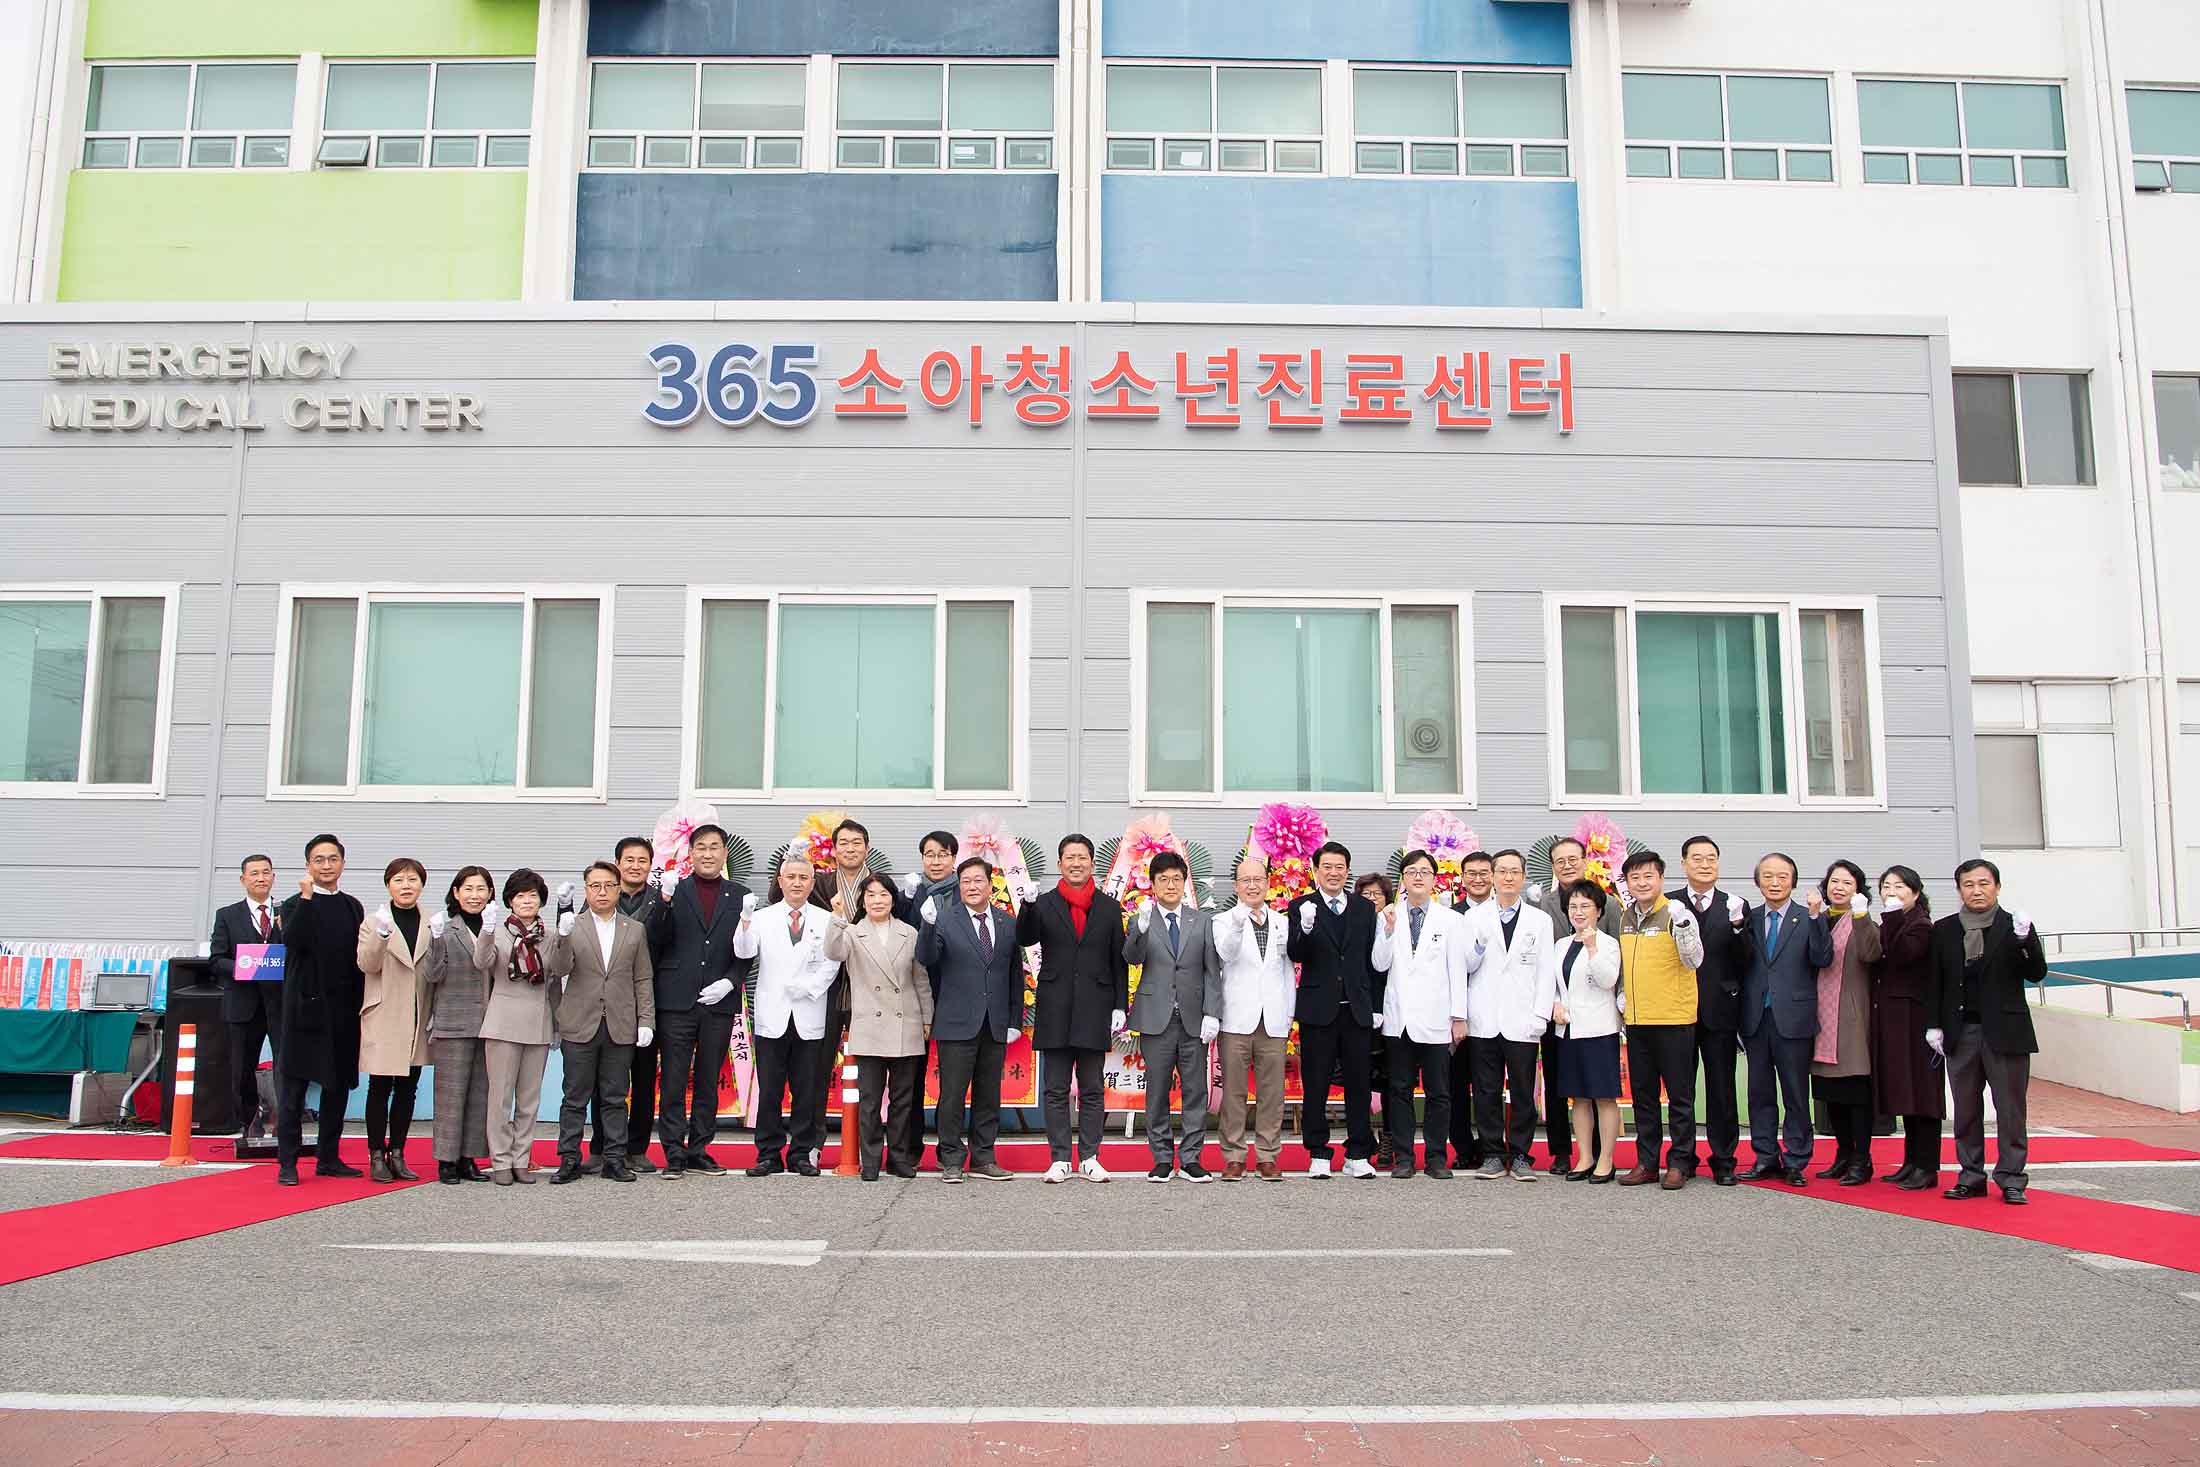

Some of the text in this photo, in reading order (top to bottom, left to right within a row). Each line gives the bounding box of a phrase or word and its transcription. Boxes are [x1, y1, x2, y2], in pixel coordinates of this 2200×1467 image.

[47, 342, 355, 380] EMERGENCY
[640, 341, 1577, 434] 365 소아청소년진료센터
[42, 390, 485, 432] MEDICAL CENTER
